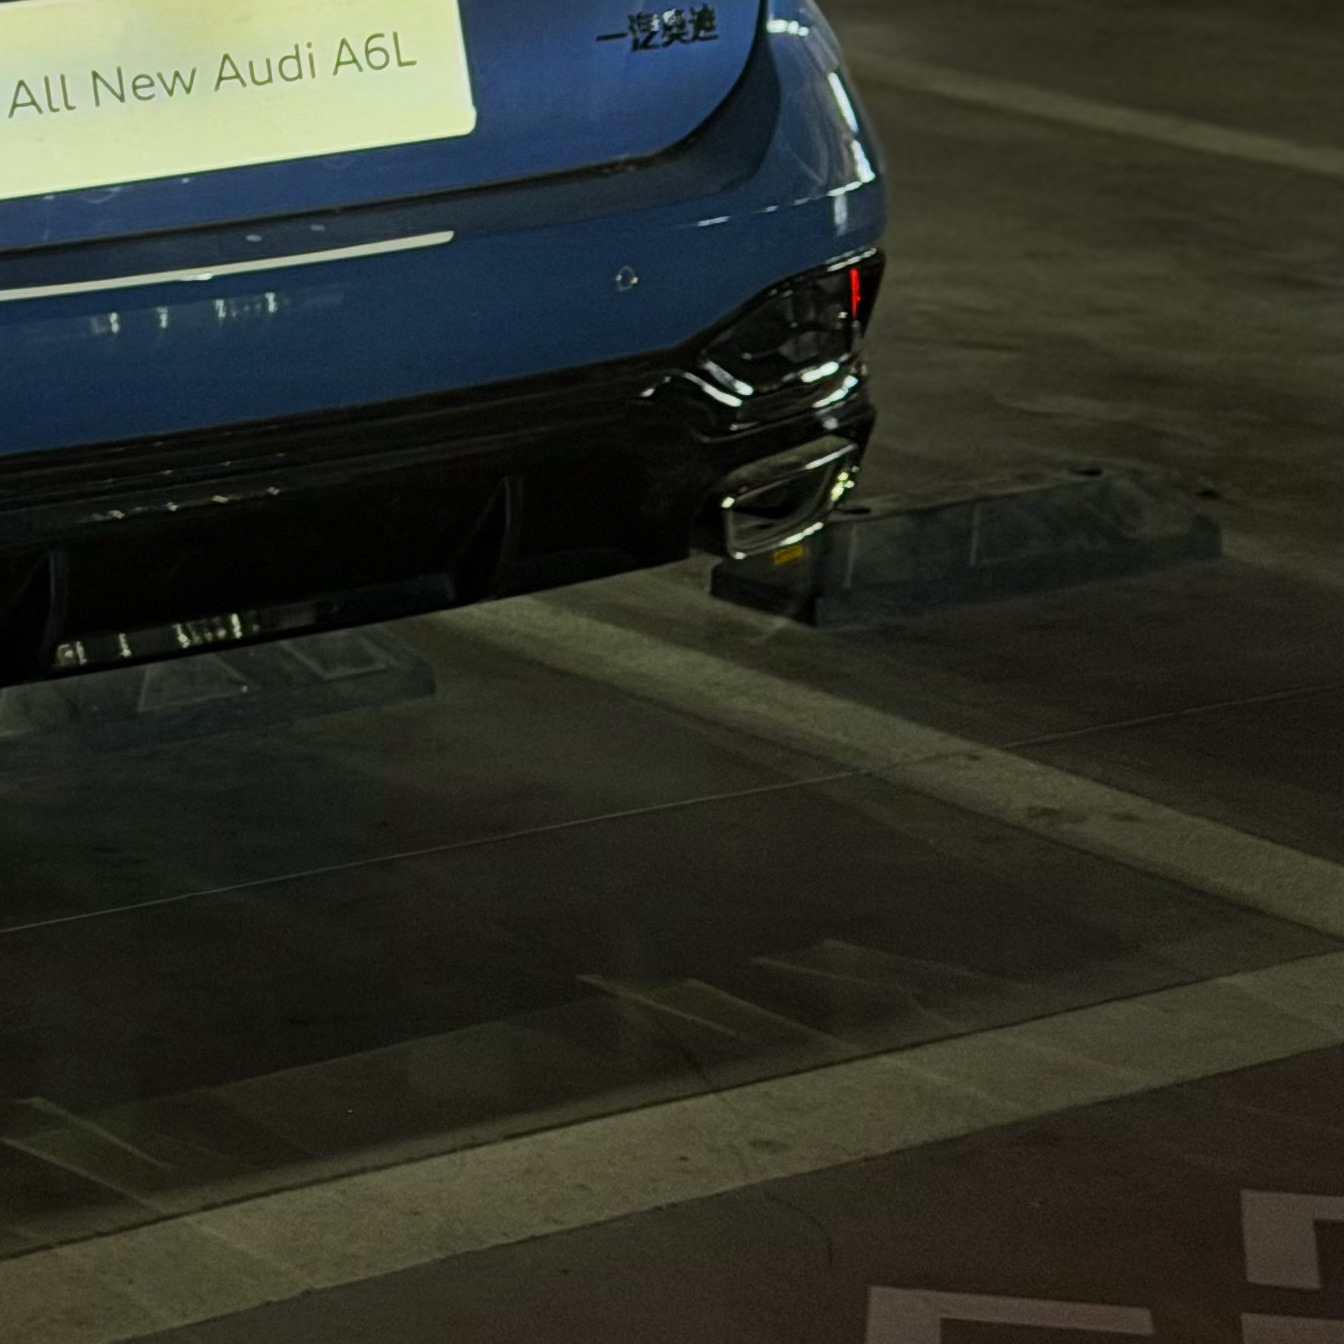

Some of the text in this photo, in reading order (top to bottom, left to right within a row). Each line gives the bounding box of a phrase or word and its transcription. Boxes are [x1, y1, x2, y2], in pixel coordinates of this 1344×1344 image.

[8, 32, 418, 119] All New Audi A6L
